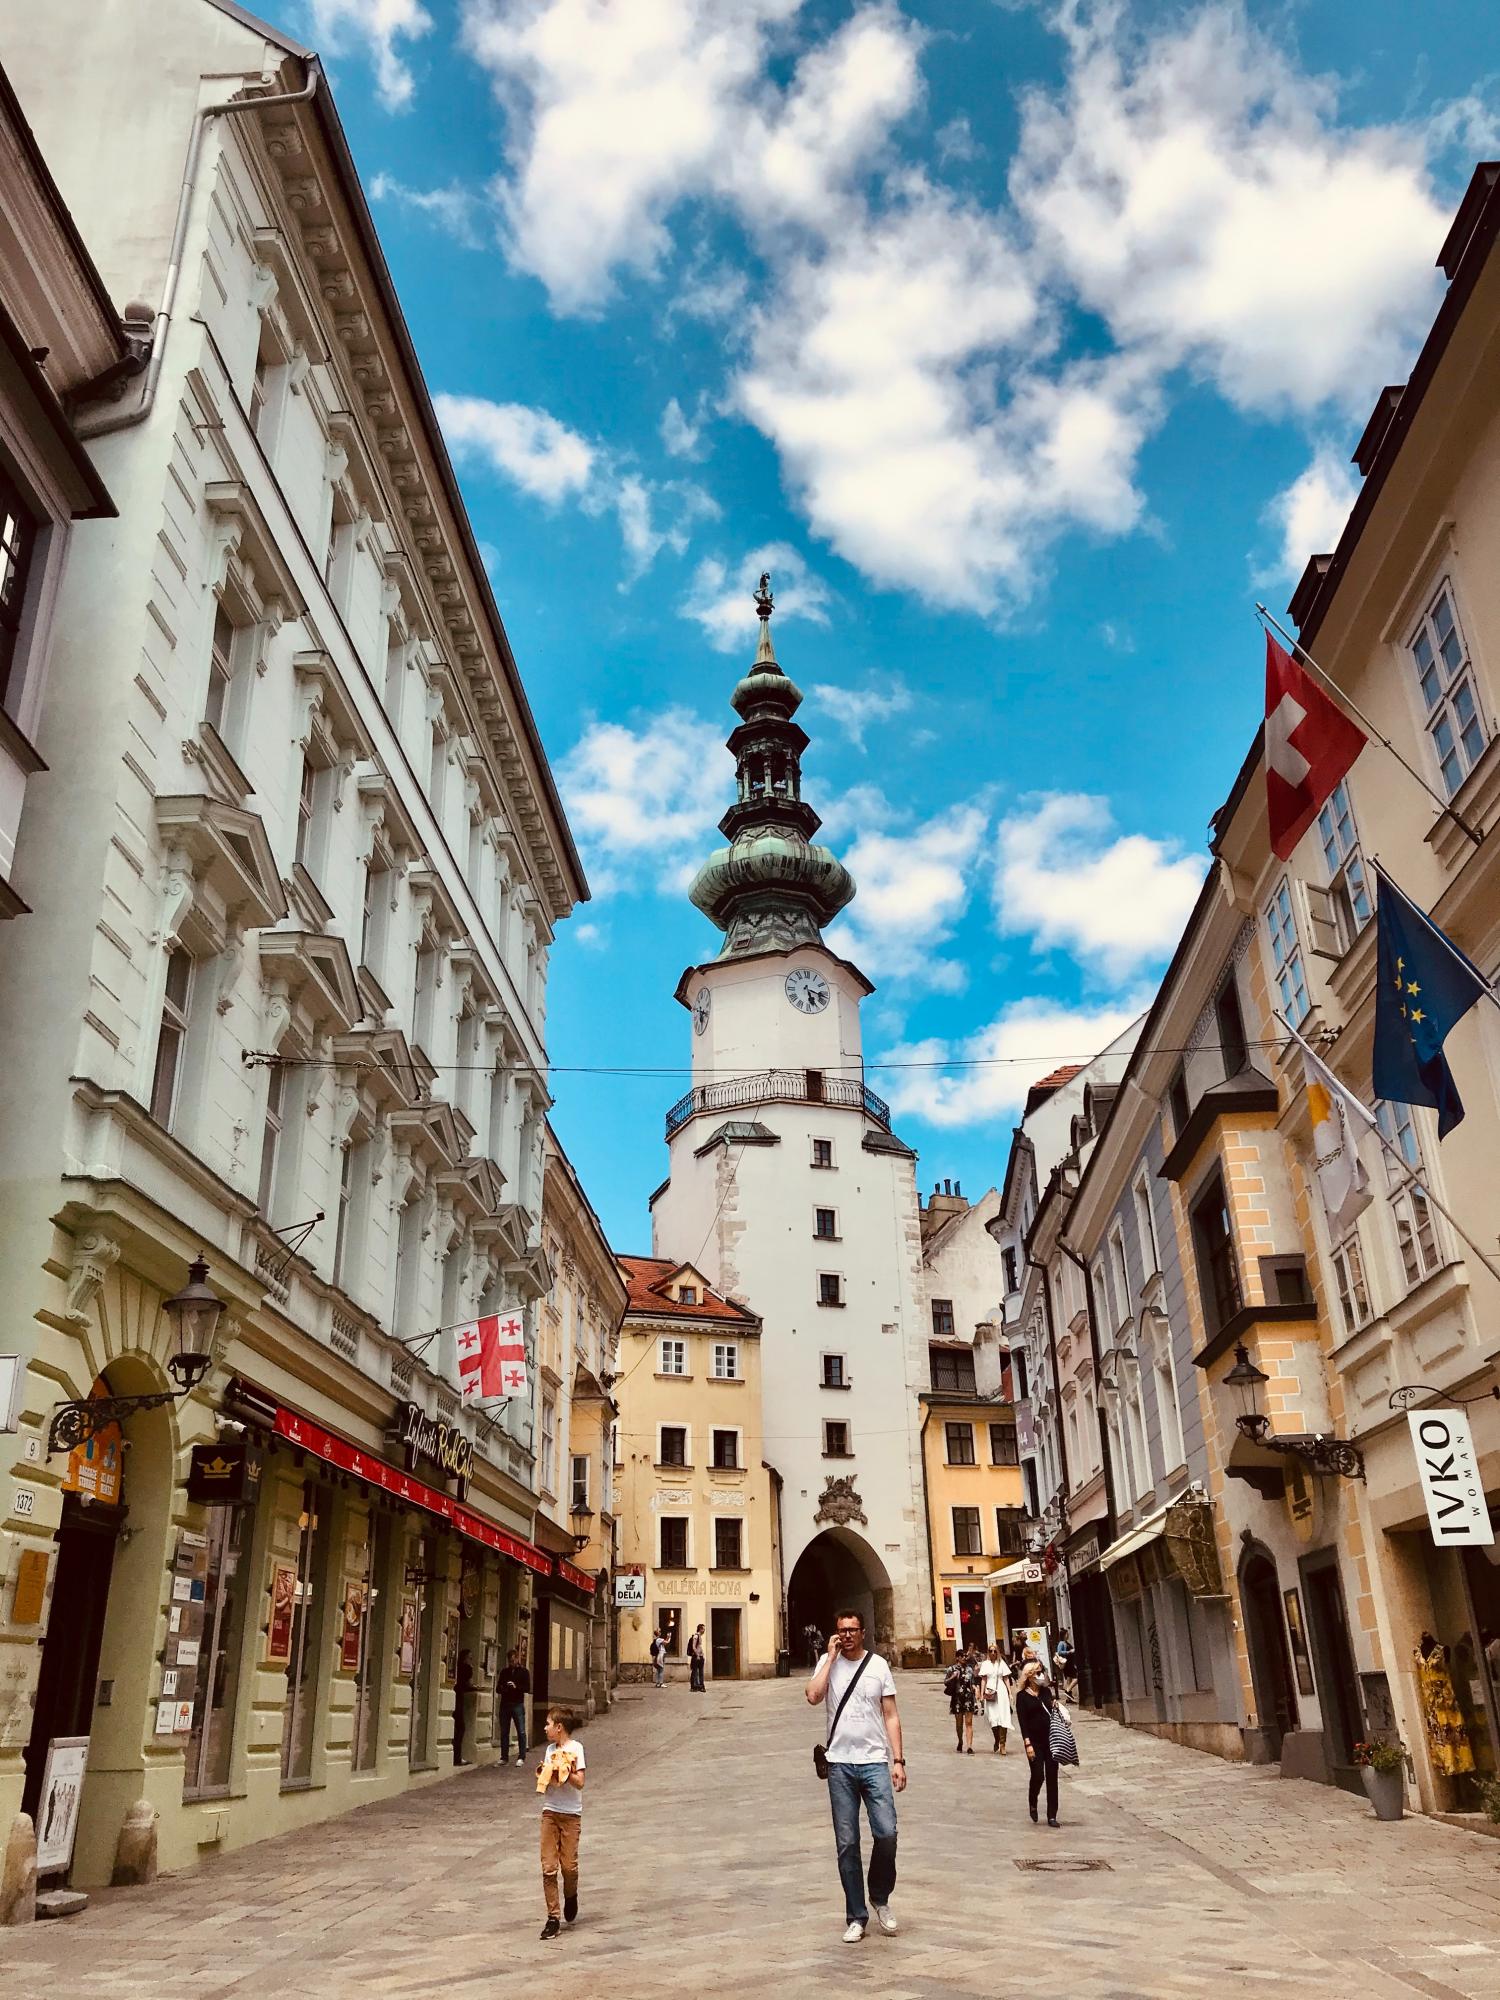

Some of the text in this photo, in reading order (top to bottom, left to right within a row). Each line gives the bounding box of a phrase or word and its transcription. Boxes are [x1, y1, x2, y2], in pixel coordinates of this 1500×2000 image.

[403, 1404, 437, 1470] Infiniti
[30, 1442, 35, 1457] 9
[1419, 1419, 1471, 1535] IVKO
[1456, 1436, 1481, 1516] WOMAN
[16, 1495, 33, 1512] 1372
[617, 1591, 643, 1599] DELIA
[657, 1577, 742, 1596] GALÉRIA NOVA
